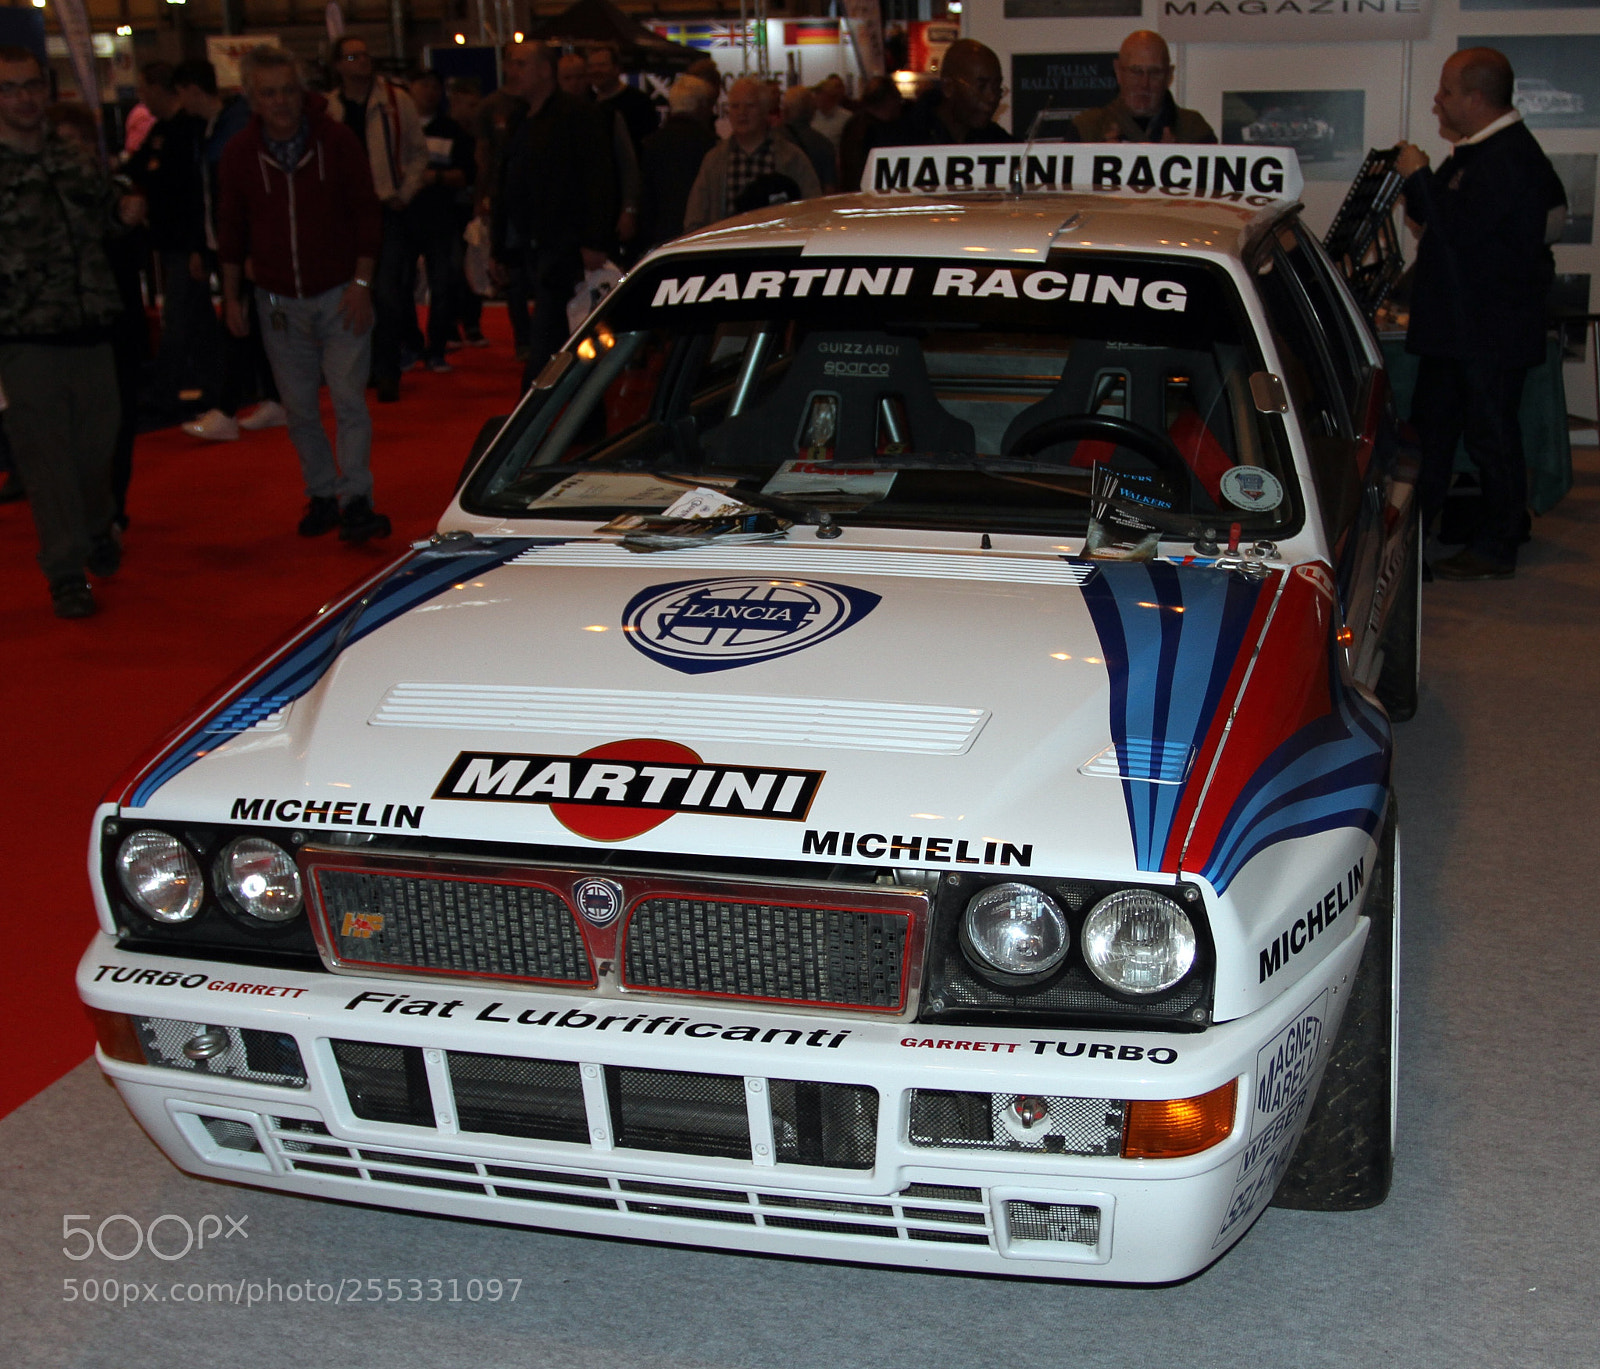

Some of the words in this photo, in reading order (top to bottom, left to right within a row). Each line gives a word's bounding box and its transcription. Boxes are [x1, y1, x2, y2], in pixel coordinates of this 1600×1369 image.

[1164, 0, 1422, 15] MAGAZINE
[1021, 77, 1061, 91] RALLY
[1047, 63, 1099, 77] ITALIAN
[874, 156, 1074, 189] MARTINI
[1093, 155, 1284, 194] RACING
[651, 267, 914, 307] MARTINI
[933, 268, 1188, 312] RACING
[818, 342, 901, 356] GUIZZARDI
[824, 361, 890, 377] sparco
[1120, 488, 1173, 509] WALKERS
[683, 603, 793, 621] LANCIA
[452, 759, 807, 812] MARTINI
[230, 797, 425, 829] MICHELIN
[801, 829, 1034, 868] MICHELIN
[1260, 857, 1364, 984] MICHELIN
[93, 965, 208, 989] TURBO
[207, 980, 309, 999] GARRETT
[344, 991, 465, 1017] Fiat
[474, 1001, 853, 1049] Lubrificanti
[900, 1037, 1022, 1054] GARRETT
[1029, 1040, 1179, 1065] TURBO
[1244, 1088, 1308, 1172] WEBER
